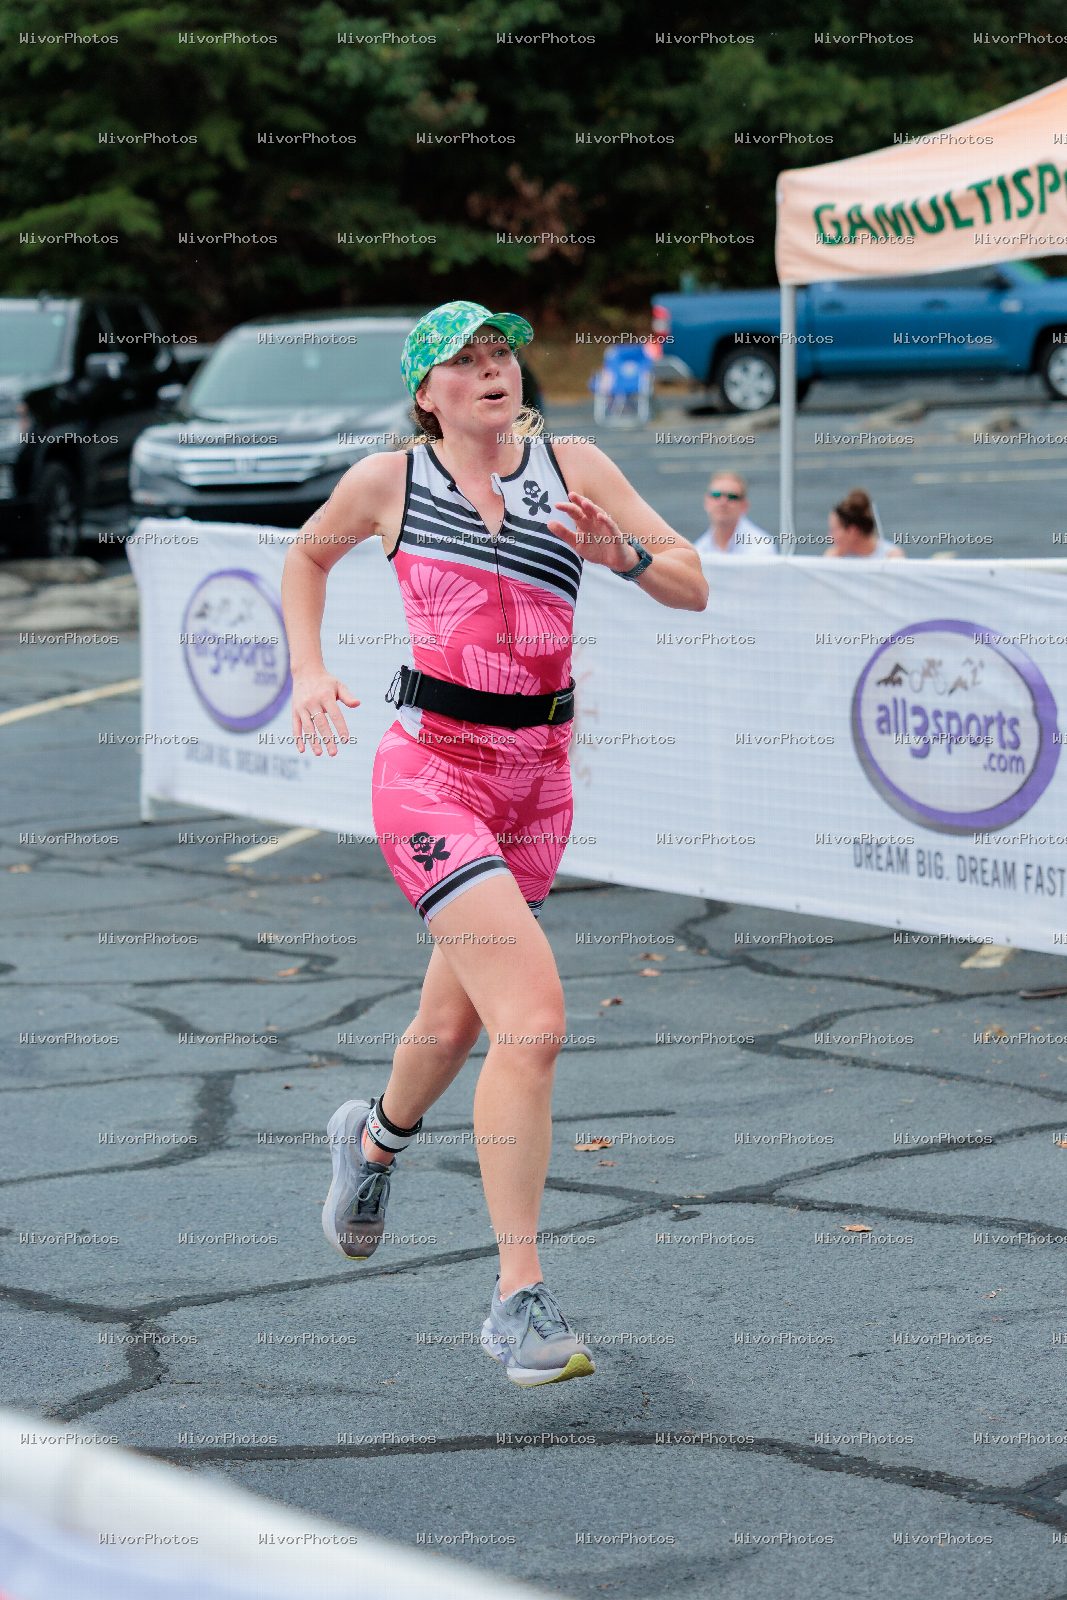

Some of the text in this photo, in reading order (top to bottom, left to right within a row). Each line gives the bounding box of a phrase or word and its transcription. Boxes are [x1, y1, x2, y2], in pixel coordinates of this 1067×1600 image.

[813, 162, 1067, 246] GAMULTISP
[876, 697, 1022, 759] all3sports
[982, 752, 1026, 775] .com
[853, 839, 910, 876] DREAM
[957, 854, 1018, 891] DREAM
